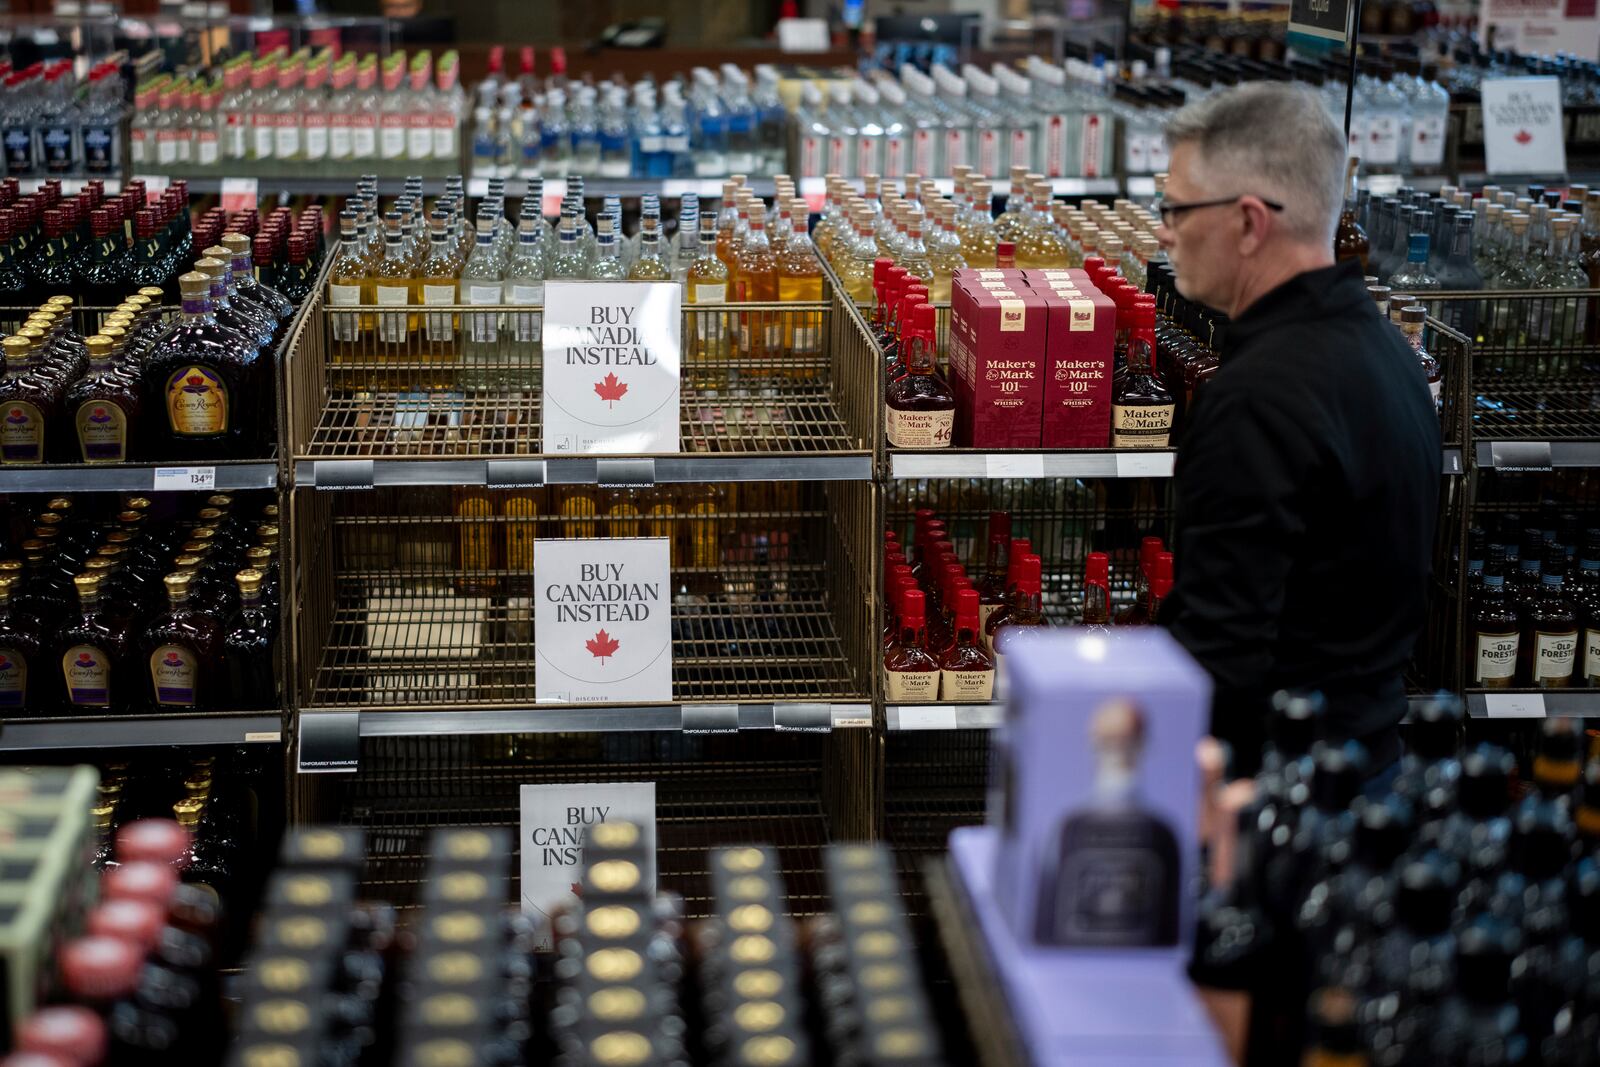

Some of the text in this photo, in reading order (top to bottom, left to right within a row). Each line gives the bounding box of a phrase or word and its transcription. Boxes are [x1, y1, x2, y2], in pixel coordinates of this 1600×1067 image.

[591, 306, 635, 325] BUY
[566, 347, 657, 366] INSTEAD
[986, 360, 1036, 369] Maker's
[1055, 360, 1105, 369] Maker's
[1000, 370, 1035, 379] Mark
[1068, 370, 1105, 379] Mark
[1000, 381, 1020, 392] 101
[1069, 381, 1089, 392] 101
[1123, 409, 1170, 418] Maker's
[1135, 418, 1168, 428] Mark
[934, 427, 952, 441] 46
[581, 563, 624, 582] BUY
[546, 583, 659, 602] CANADIAN
[557, 603, 650, 622] INSTEAD
[1497, 643, 1512, 651] OLD
[567, 806, 610, 825] BUY
